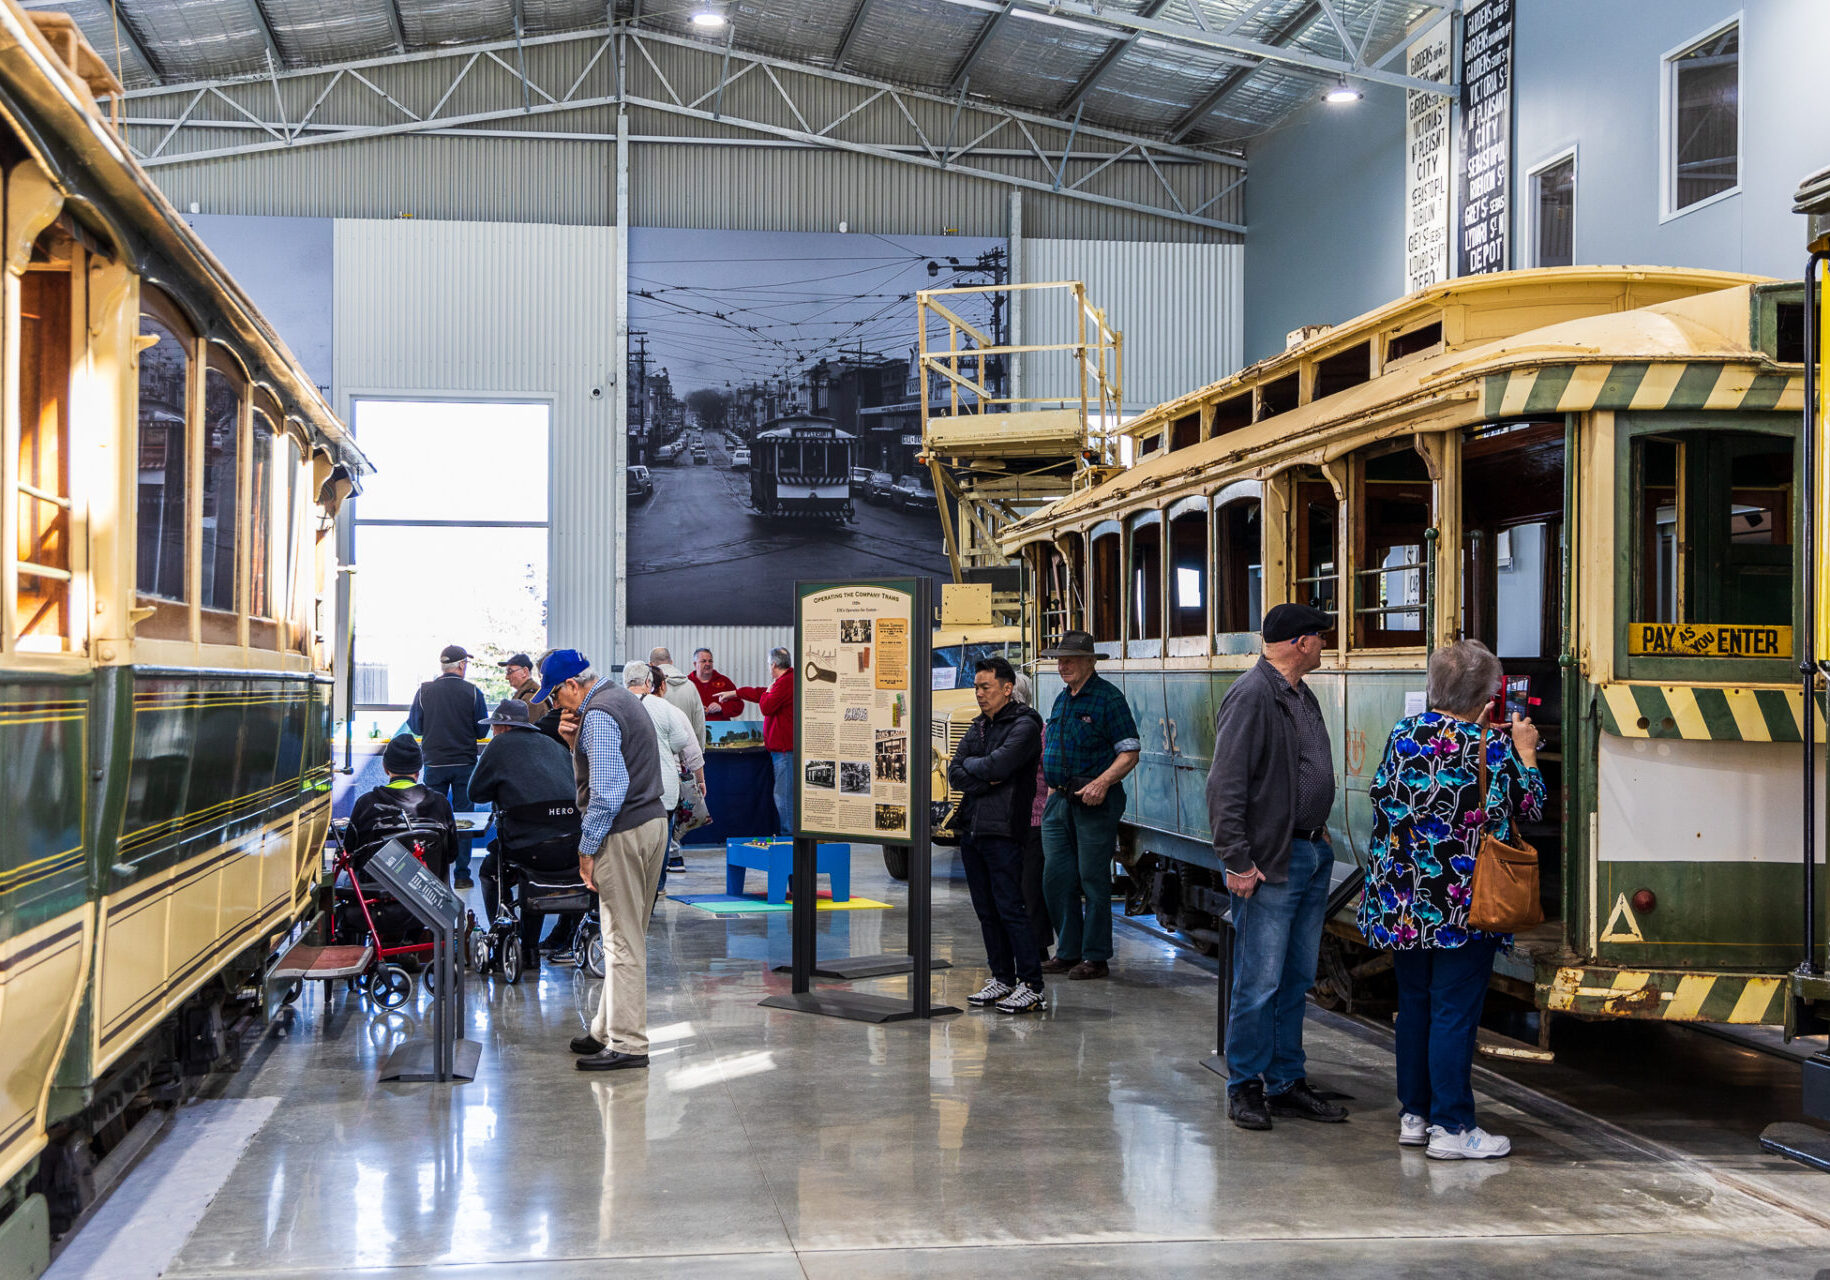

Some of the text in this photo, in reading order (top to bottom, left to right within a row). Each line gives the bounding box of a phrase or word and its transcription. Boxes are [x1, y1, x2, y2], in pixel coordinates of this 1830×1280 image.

[1467, 2, 1493, 38] GARDENS
[1465, 28, 1489, 63] GARDENS
[1466, 50, 1491, 85] GARDENS
[1469, 70, 1498, 107] VICTORIA
[1477, 88, 1508, 123] PLEASANT
[1475, 117, 1499, 149] CITY
[1416, 153, 1438, 181] CITY
[1469, 236, 1503, 273] DEPOT
[813, 593, 843, 604] OPERATING
[882, 592, 900, 602] TRAMS
[1643, 626, 1778, 654] PAY AS YOU ENTER
[548, 806, 574, 816] HERO
